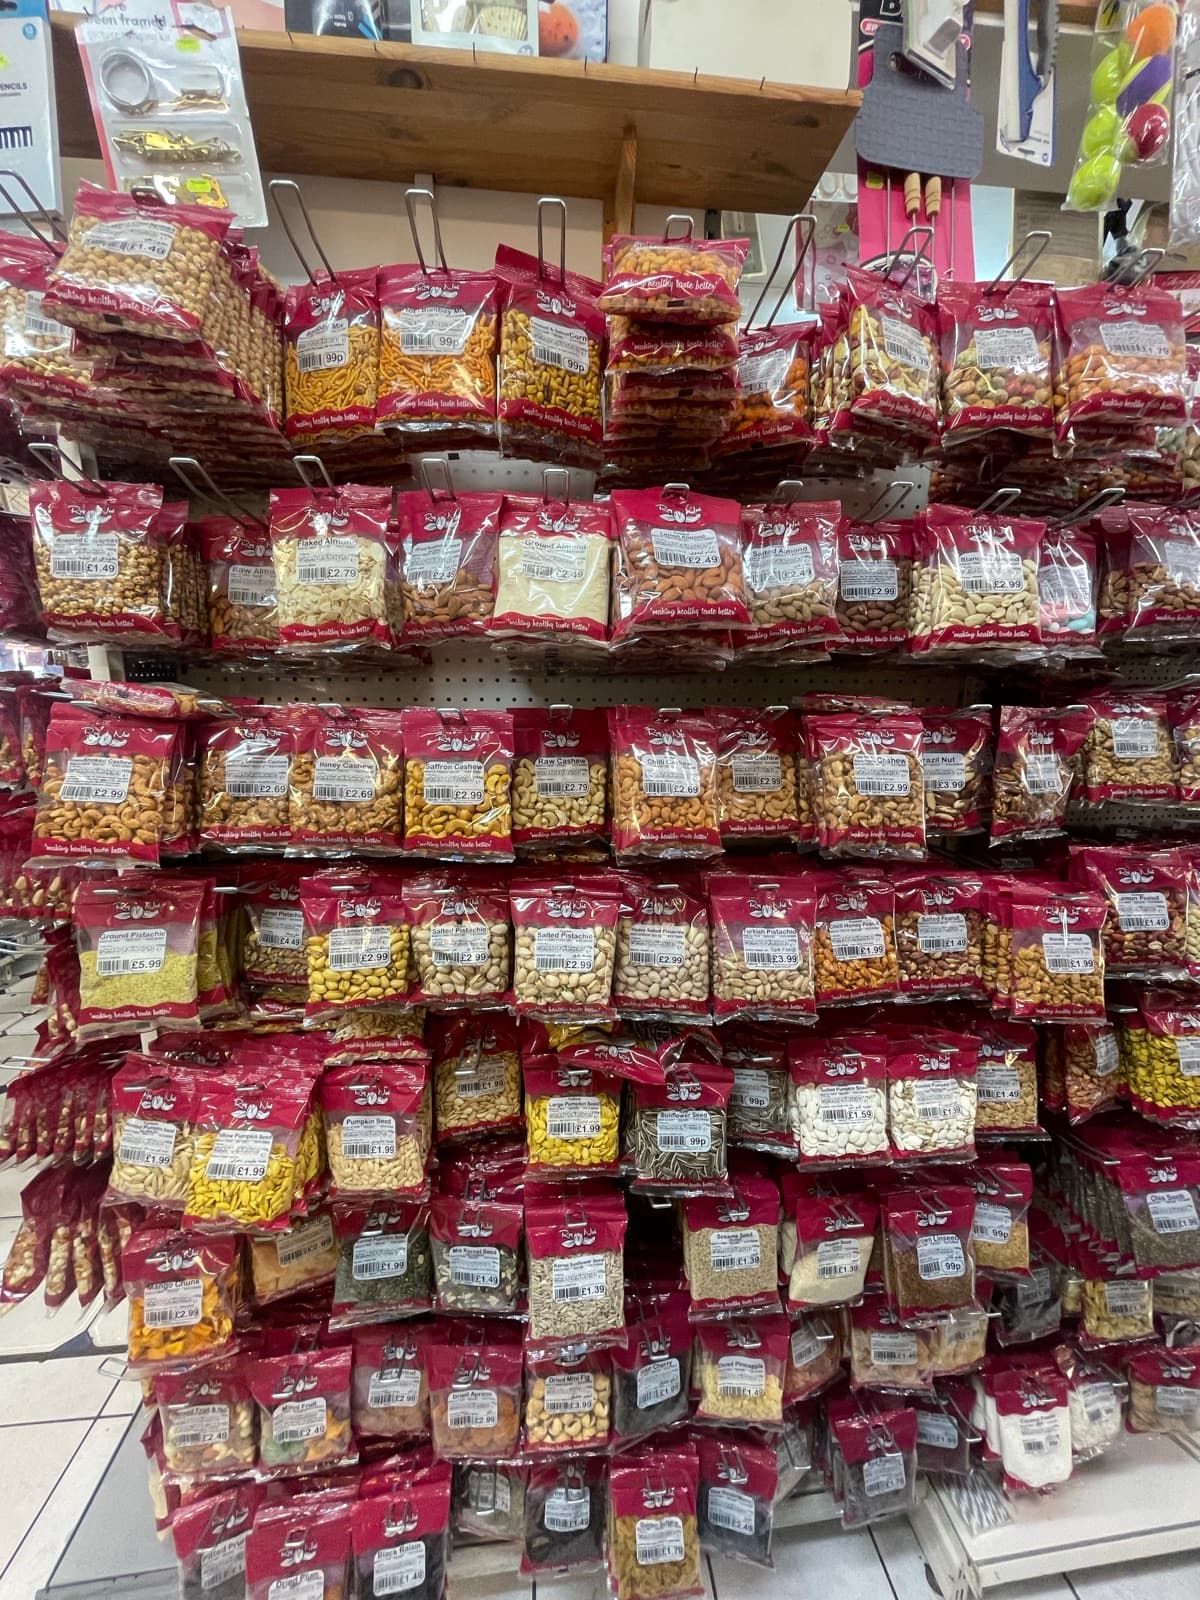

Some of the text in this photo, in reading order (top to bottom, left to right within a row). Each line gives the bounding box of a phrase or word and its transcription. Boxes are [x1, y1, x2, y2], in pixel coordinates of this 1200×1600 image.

[675, 278, 694, 290] taste
[568, 331, 588, 342] Corn
[439, 336, 459, 349] 99p
[325, 353, 344, 364] 99p
[567, 358, 586, 373] 99p
[297, 539, 323, 547] Flaked
[524, 539, 587, 551] Ground Almond
[687, 554, 718, 564] £2.49
[86, 562, 116, 573] £1.49
[231, 566, 251, 576] Raw
[327, 568, 357, 578] £2.79
[555, 568, 583, 579] £2.49
[783, 568, 812, 580] £2.49
[993, 579, 1021, 589] £2.99
[870, 586, 895, 596] £2.99
[676, 607, 700, 619] healthy
[700, 607, 716, 616] taste
[532, 618, 554, 631] healthy
[555, 620, 570, 630] taste
[976, 629, 998, 641] healthy
[998, 629, 1014, 638] taste
[537, 757, 586, 765] Raw Cashew
[647, 758, 667, 766] Chilli
[941, 755, 956, 763] Nut
[426, 762, 483, 771] Saffron Cashew
[759, 777, 781, 786] £2.99
[938, 780, 964, 790] £3.99
[259, 785, 286, 793] £2.69
[564, 783, 588, 792] £2.79
[673, 784, 699, 794] £2.69
[884, 782, 908, 792] £2.99
[94, 789, 124, 799] £2.99
[344, 790, 374, 799] £2.69
[454, 790, 483, 800] £2.99
[1138, 894, 1160, 902] Peanut
[1144, 918, 1167, 927] £1.49
[431, 926, 487, 935] Salted Pistachio
[536, 931, 593, 940] Salted Pistachio
[100, 931, 167, 941] Ground Pistachio
[279, 937, 300, 947] £4.49
[945, 939, 967, 948] £1.49
[859, 945, 884, 955] £1.99
[361, 952, 389, 963] £2.99
[459, 953, 487, 962] £2.99
[658, 955, 683, 965] £2.99
[772, 954, 798, 964] £3.99
[131, 959, 162, 970] £5.99
[565, 959, 592, 970] £2.99
[1070, 959, 1094, 969] £1.99
[995, 1090, 1020, 1099] £1.49
[847, 1110, 872, 1120] £1.59
[346, 1118, 375, 1126] Pumpkin
[576, 1124, 600, 1133] £1.99
[234, 1132, 257, 1141] Pumpkin
[689, 1137, 706, 1146] 99p
[371, 1145, 395, 1154] £1.99
[145, 1154, 171, 1164] £1.99
[236, 1166, 265, 1177] £1.99
[716, 1231, 754, 1240] Sesame Seed
[992, 1229, 1009, 1239] 99p
[481, 1248, 497, 1256] Seed
[380, 1261, 405, 1272] £1.99
[944, 1262, 961, 1271] 99p
[474, 1274, 499, 1285] £1.49
[581, 1284, 606, 1297] £1.39
[174, 1308, 200, 1320] £2.99
[652, 1360, 673, 1370] Cherry
[565, 1375, 578, 1383] Mini
[300, 1400, 317, 1409] Fruit
[570, 1402, 593, 1410] £3.99
[474, 1415, 496, 1425] £2.99
[202, 1432, 228, 1442] £2.49
[377, 1548, 398, 1558] Black
